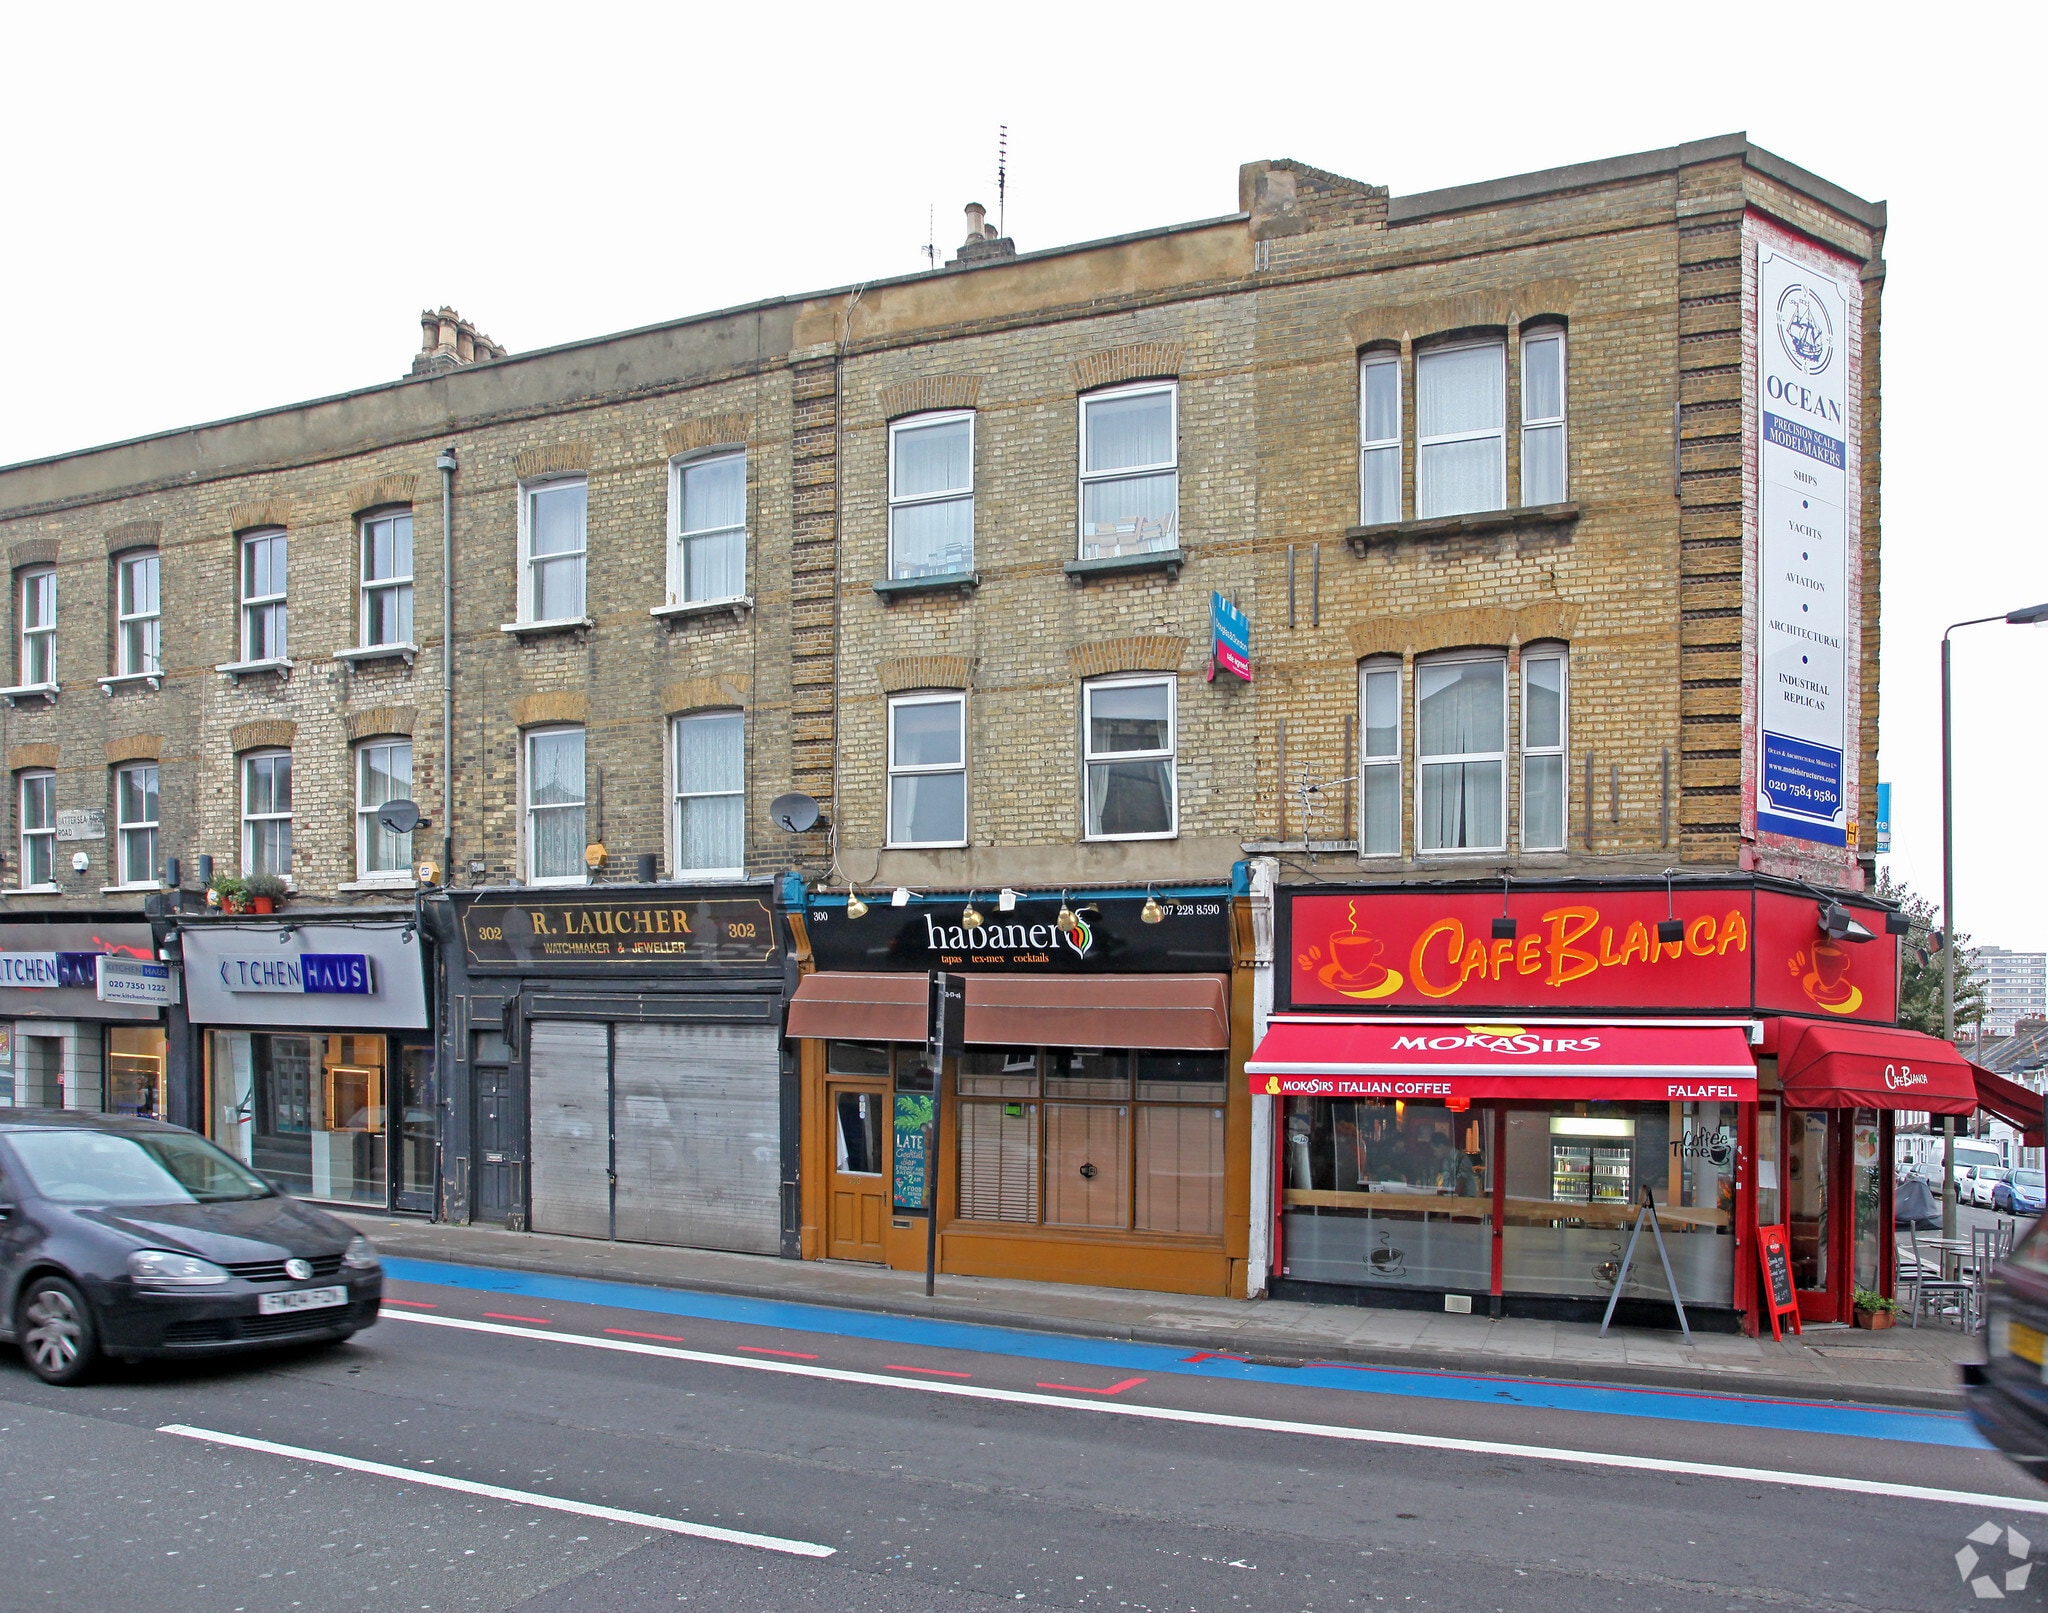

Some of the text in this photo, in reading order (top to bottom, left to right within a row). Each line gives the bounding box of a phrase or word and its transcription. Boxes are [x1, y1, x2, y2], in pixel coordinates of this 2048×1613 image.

[1766, 375, 1841, 424] OCEAN
[1773, 416, 1837, 451] PRECISION SCALE
[1793, 469, 1818, 487] SHIPS
[1788, 519, 1823, 540] YACHTS
[1785, 572, 1826, 592] AVIATION
[1768, 619, 1841, 649] ARCHITECTURAL
[1778, 672, 1830, 696] INDUSTRIAL
[1783, 691, 1825, 711] REPLICAS
[1768, 779, 1837, 803] 020 7584 9580
[57, 828, 73, 837] ROAD
[813, 911, 829, 922] 300
[1160, 904, 1220, 916] 07 228 8590
[530, 908, 692, 935] R. LAUCHER
[478, 926, 503, 941] 302
[728, 923, 756, 938] 302
[543, 940, 687, 954] WATCHMAKER & JEWELLER
[940, 952, 1050, 966] tapas tex-mex cocktails
[106, 964, 169, 977] KITCHEN HAUS
[306, 961, 363, 987] HAUS
[108, 980, 166, 992] 020 7350 1222
[1390, 1034, 1601, 1055] MOKASIRS
[1282, 1079, 1452, 1094] MOKASIRS ITALIAN COFFEE
[1667, 1085, 1738, 1097] FALAFEL
[896, 1134, 923, 1149] LATE
[1683, 1127, 1728, 1147] Coffee
[1670, 1141, 1710, 1158] Time
